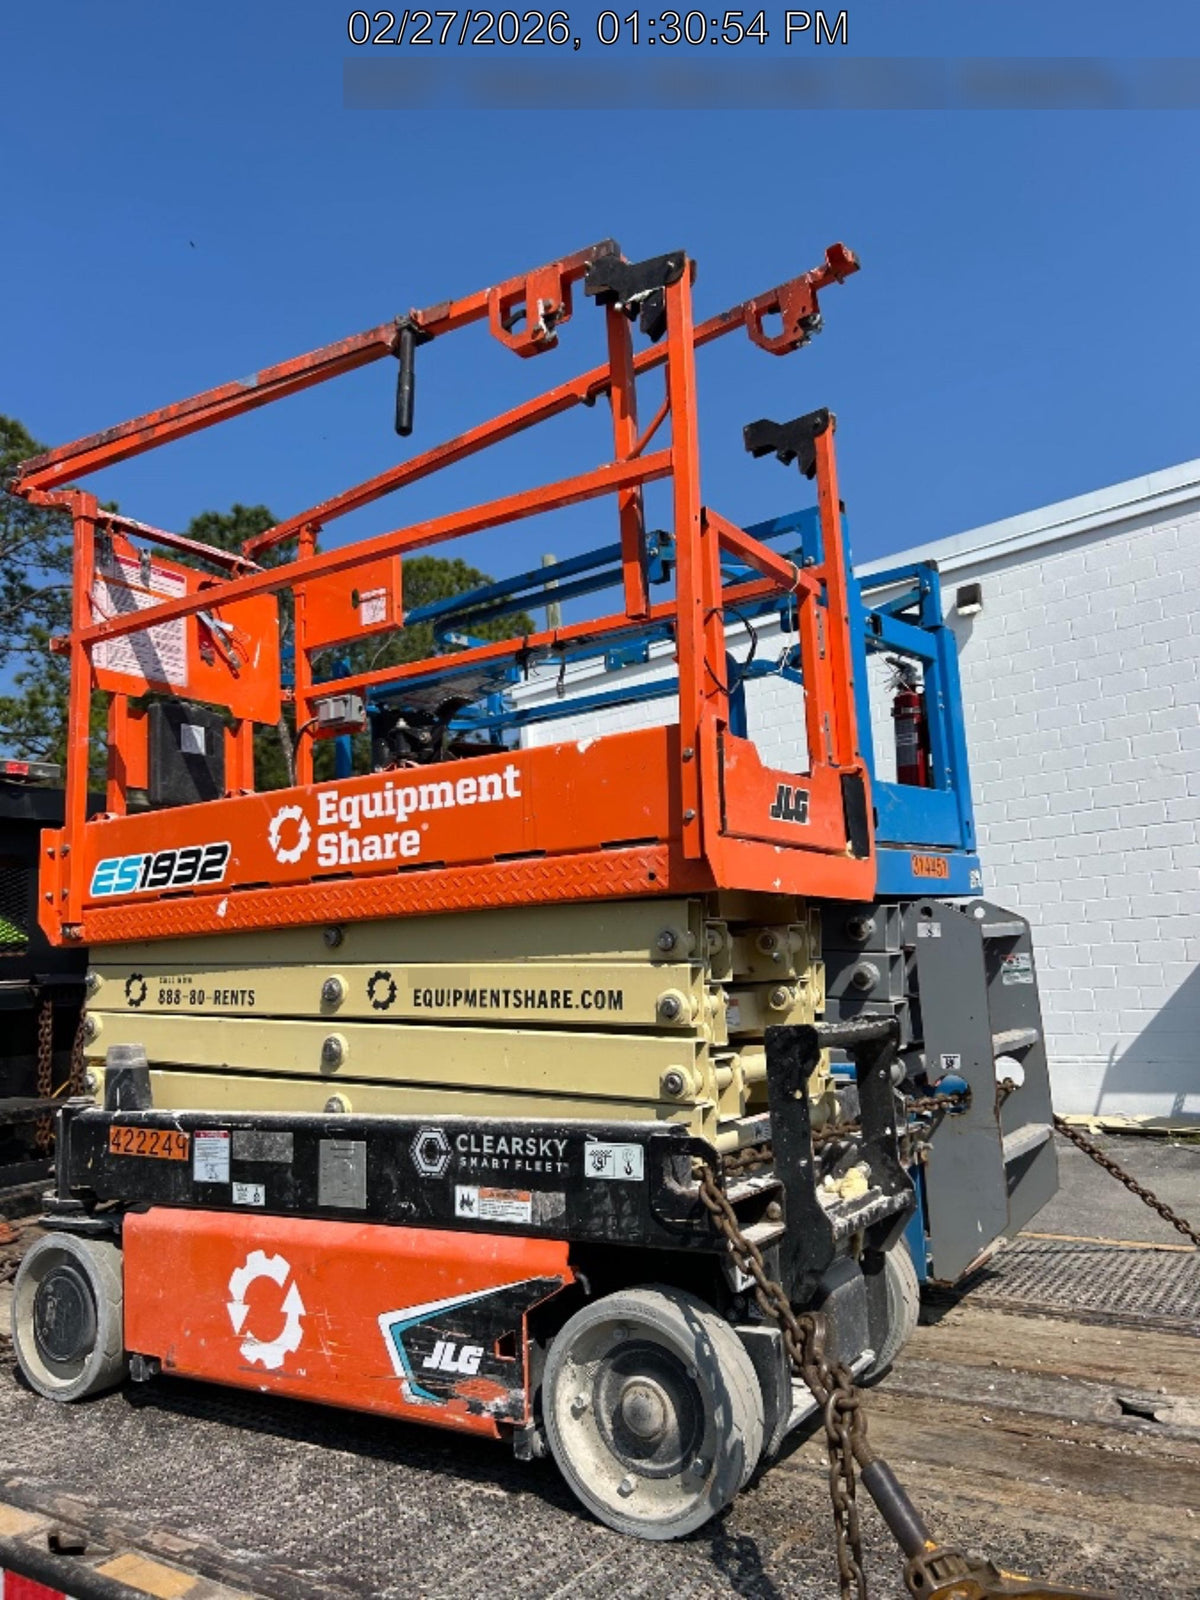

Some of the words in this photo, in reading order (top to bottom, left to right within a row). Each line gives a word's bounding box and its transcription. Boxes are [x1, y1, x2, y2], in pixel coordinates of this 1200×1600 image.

[317, 764, 522, 829] Equipment
[770, 783, 810, 825] JLG
[317, 829, 420, 867] Share
[91, 842, 230, 896] ES1932
[157, 988, 256, 1007] 888-80-RENTS
[412, 988, 624, 1011] EQUIPMENTSHARE.COM
[110, 1127, 188, 1158] 422249
[456, 1133, 568, 1157] CLEARSKY
[459, 1157, 509, 1169] SMART
[514, 1159, 564, 1173] FLEET
[422, 1340, 484, 1375] JLG
